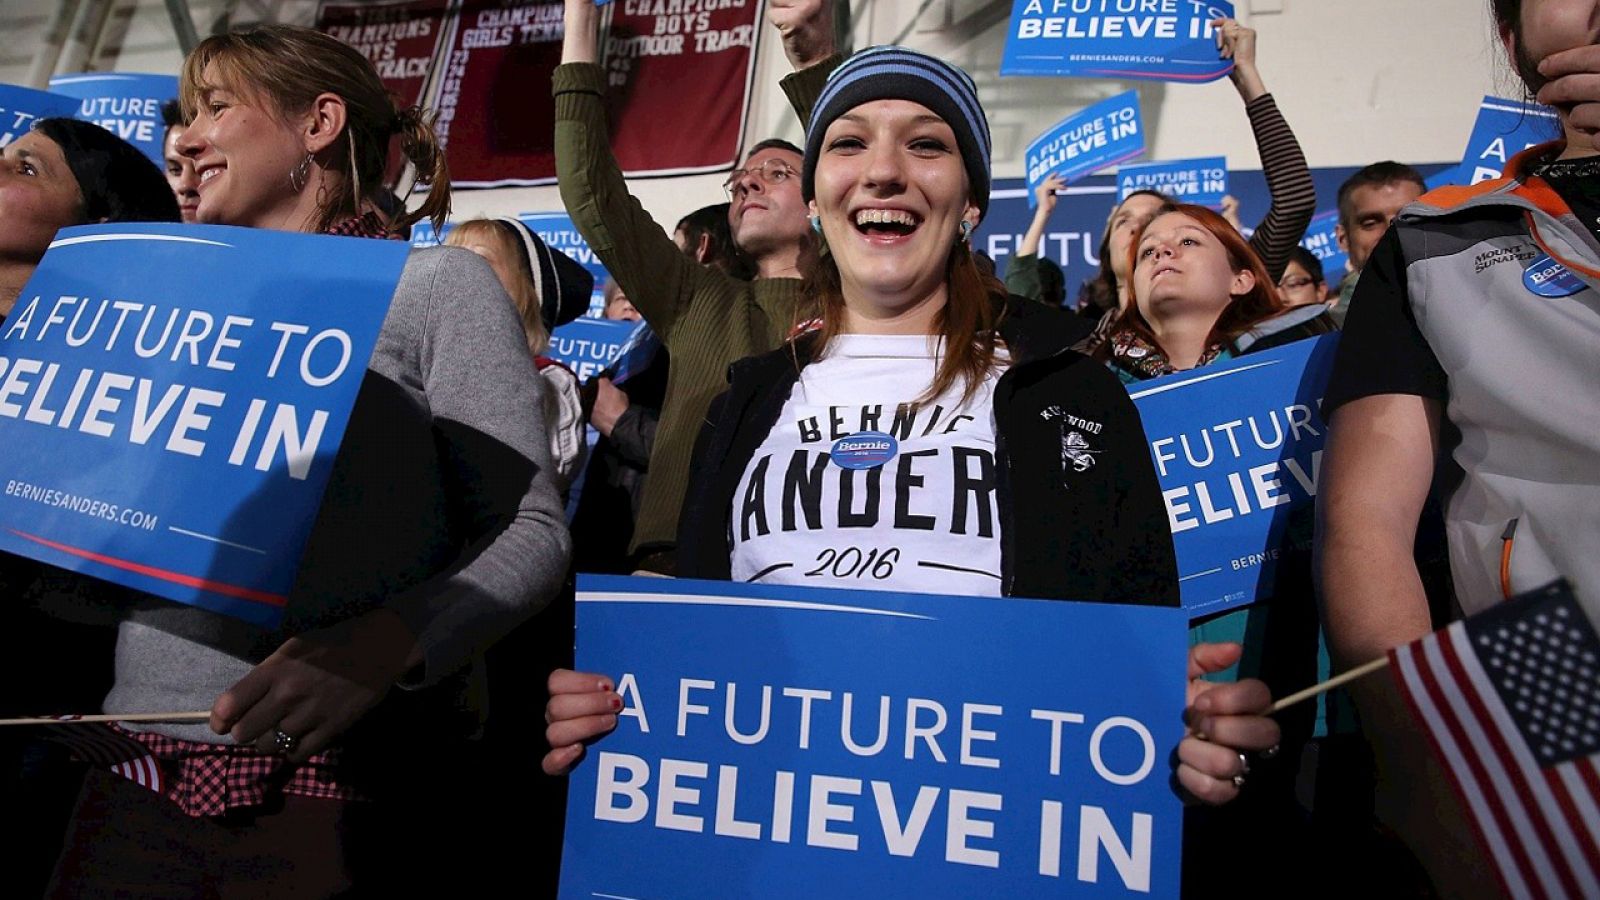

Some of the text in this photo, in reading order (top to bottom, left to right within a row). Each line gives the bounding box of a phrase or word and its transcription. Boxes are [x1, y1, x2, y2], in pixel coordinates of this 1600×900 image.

[1023, 0, 1044, 15] A
[653, 12, 711, 35] BOYS
[1018, 16, 1178, 40] BELIEVE
[462, 26, 513, 49] GIRLS
[606, 25, 755, 57] OUTDOOR TRACK
[376, 56, 431, 79] TRACK
[1069, 54, 1165, 64] BERNIESANDERS.COM
[81, 98, 158, 117] UTURE
[1028, 155, 1039, 170] A
[1040, 116, 1105, 160] FUTURE
[1106, 106, 1135, 125] TO
[1479, 137, 1507, 163] A
[1029, 130, 1107, 184] BELIEVE
[1111, 119, 1138, 141] IN
[1122, 168, 1225, 187] A FUTURE TO
[1202, 180, 1225, 193] IN
[1475, 244, 1523, 265] MOUNT
[4, 295, 352, 387] A FUTURE TO
[228, 399, 329, 480] IN
[839, 440, 891, 452] Bernie
[1152, 397, 1329, 477] FUTUR
[6, 479, 157, 531] BERNIESANDERS.COM
[804, 546, 901, 580] 2016
[616, 673, 1156, 786] A FUTURE TO
[594, 752, 1153, 893] BELIEVE IN
